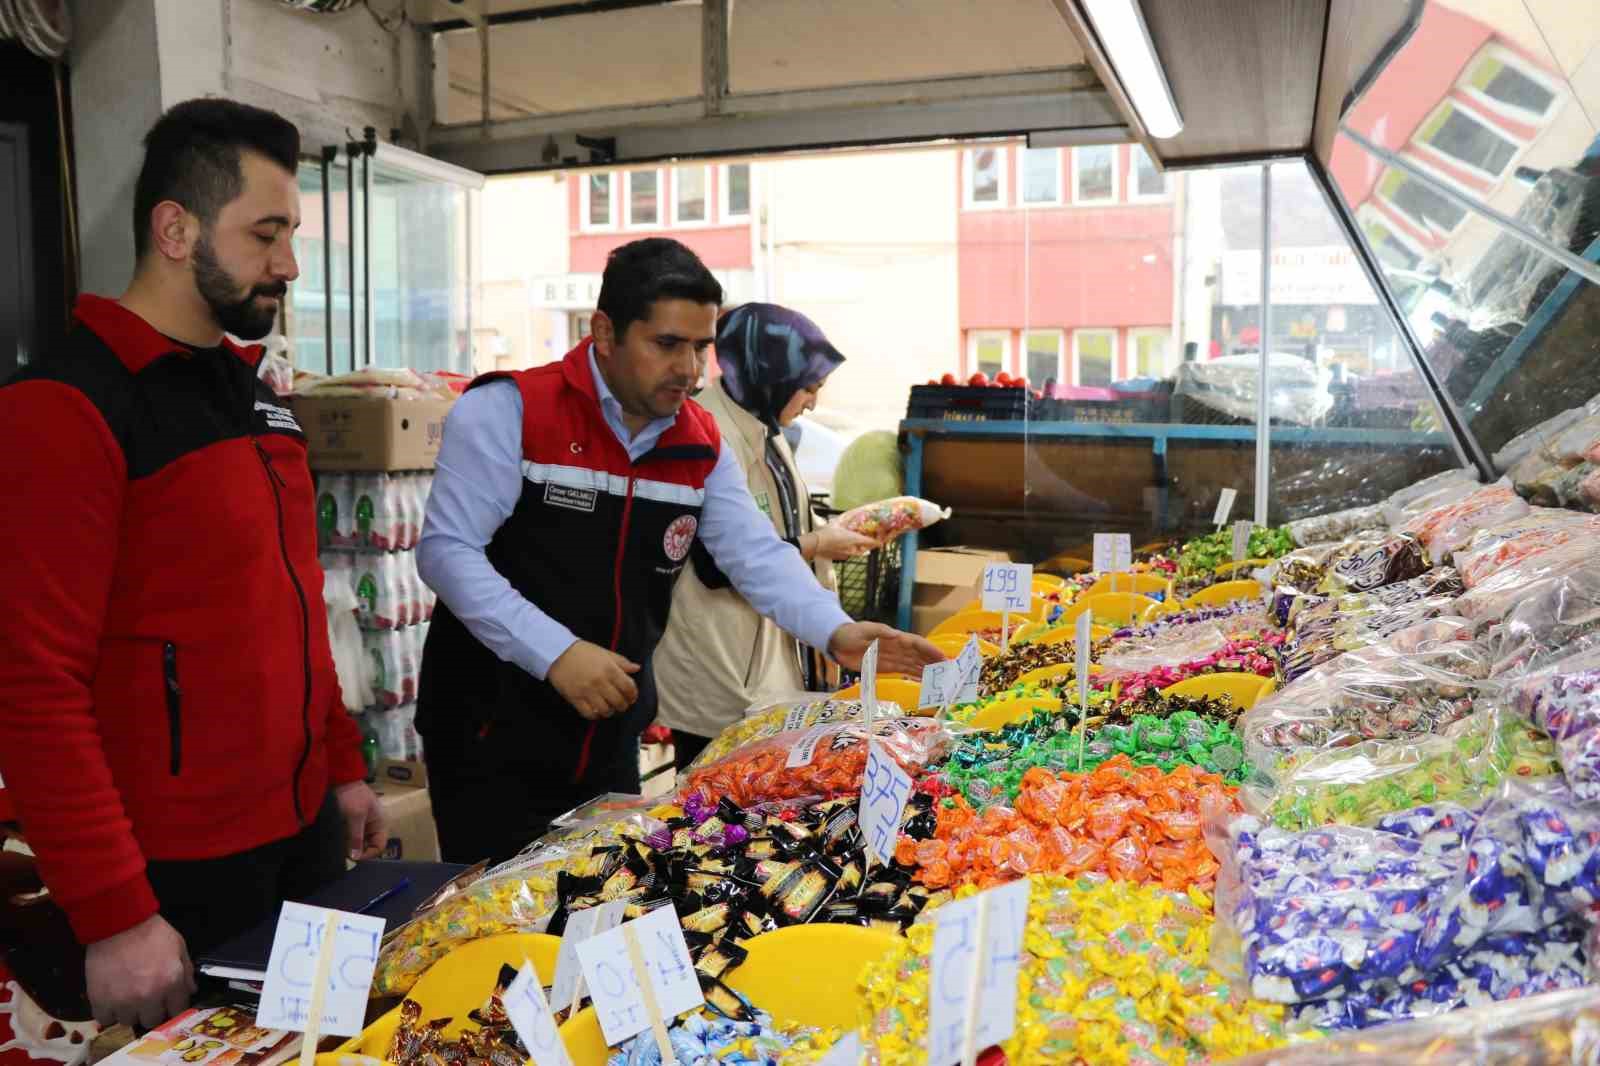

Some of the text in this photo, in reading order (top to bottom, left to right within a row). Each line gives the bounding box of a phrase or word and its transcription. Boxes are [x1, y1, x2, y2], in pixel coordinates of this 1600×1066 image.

[984, 568, 1017, 592] 199
[1006, 597, 1024, 608] TL
[863, 751, 908, 828] 375
[874, 823, 888, 859] TL
